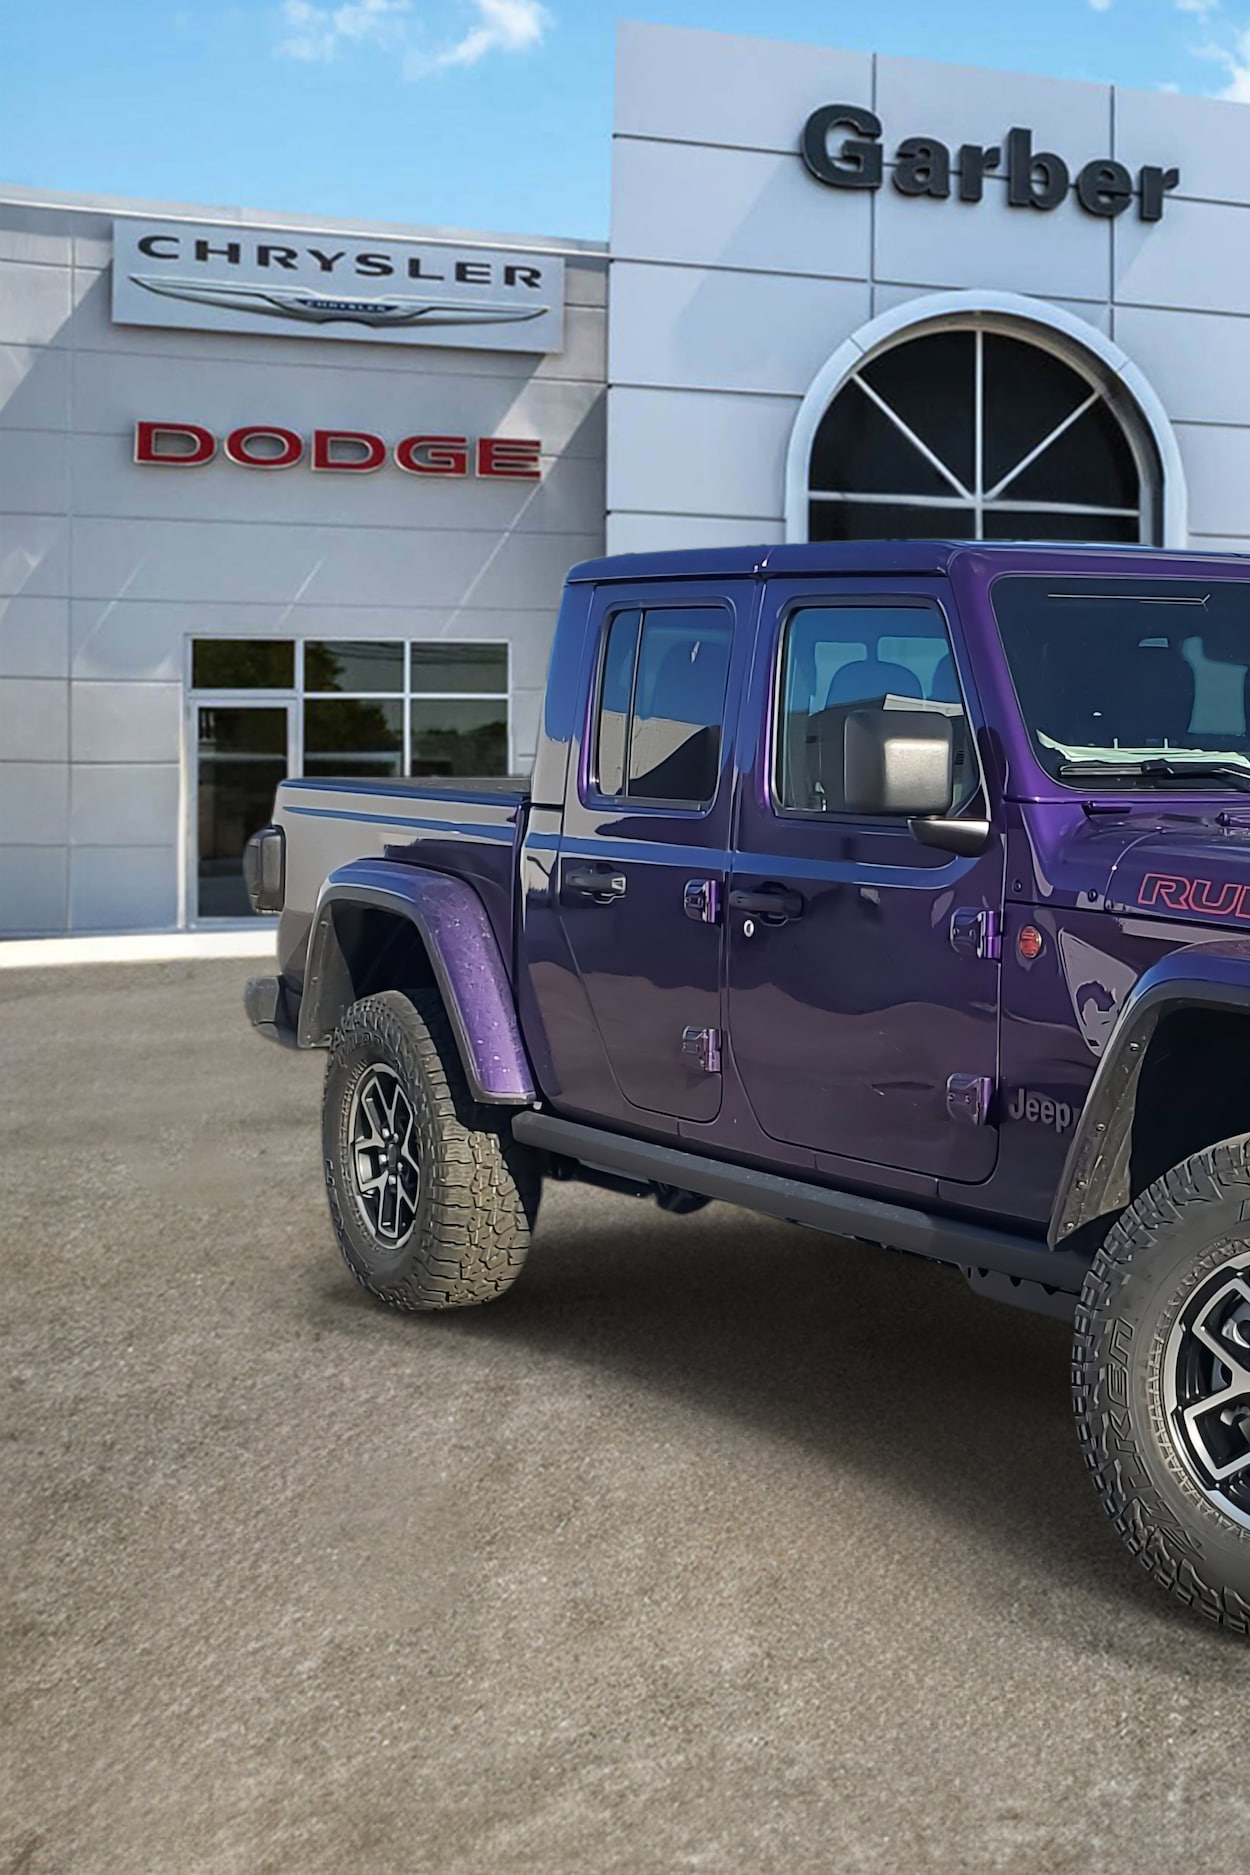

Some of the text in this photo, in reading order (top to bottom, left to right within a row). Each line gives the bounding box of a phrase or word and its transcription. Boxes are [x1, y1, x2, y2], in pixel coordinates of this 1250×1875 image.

[801, 103, 1179, 222] Garber
[138, 235, 542, 288] CHRYSLER
[135, 421, 542, 479] DODGE
[1009, 1088, 1071, 1133] Jeep
